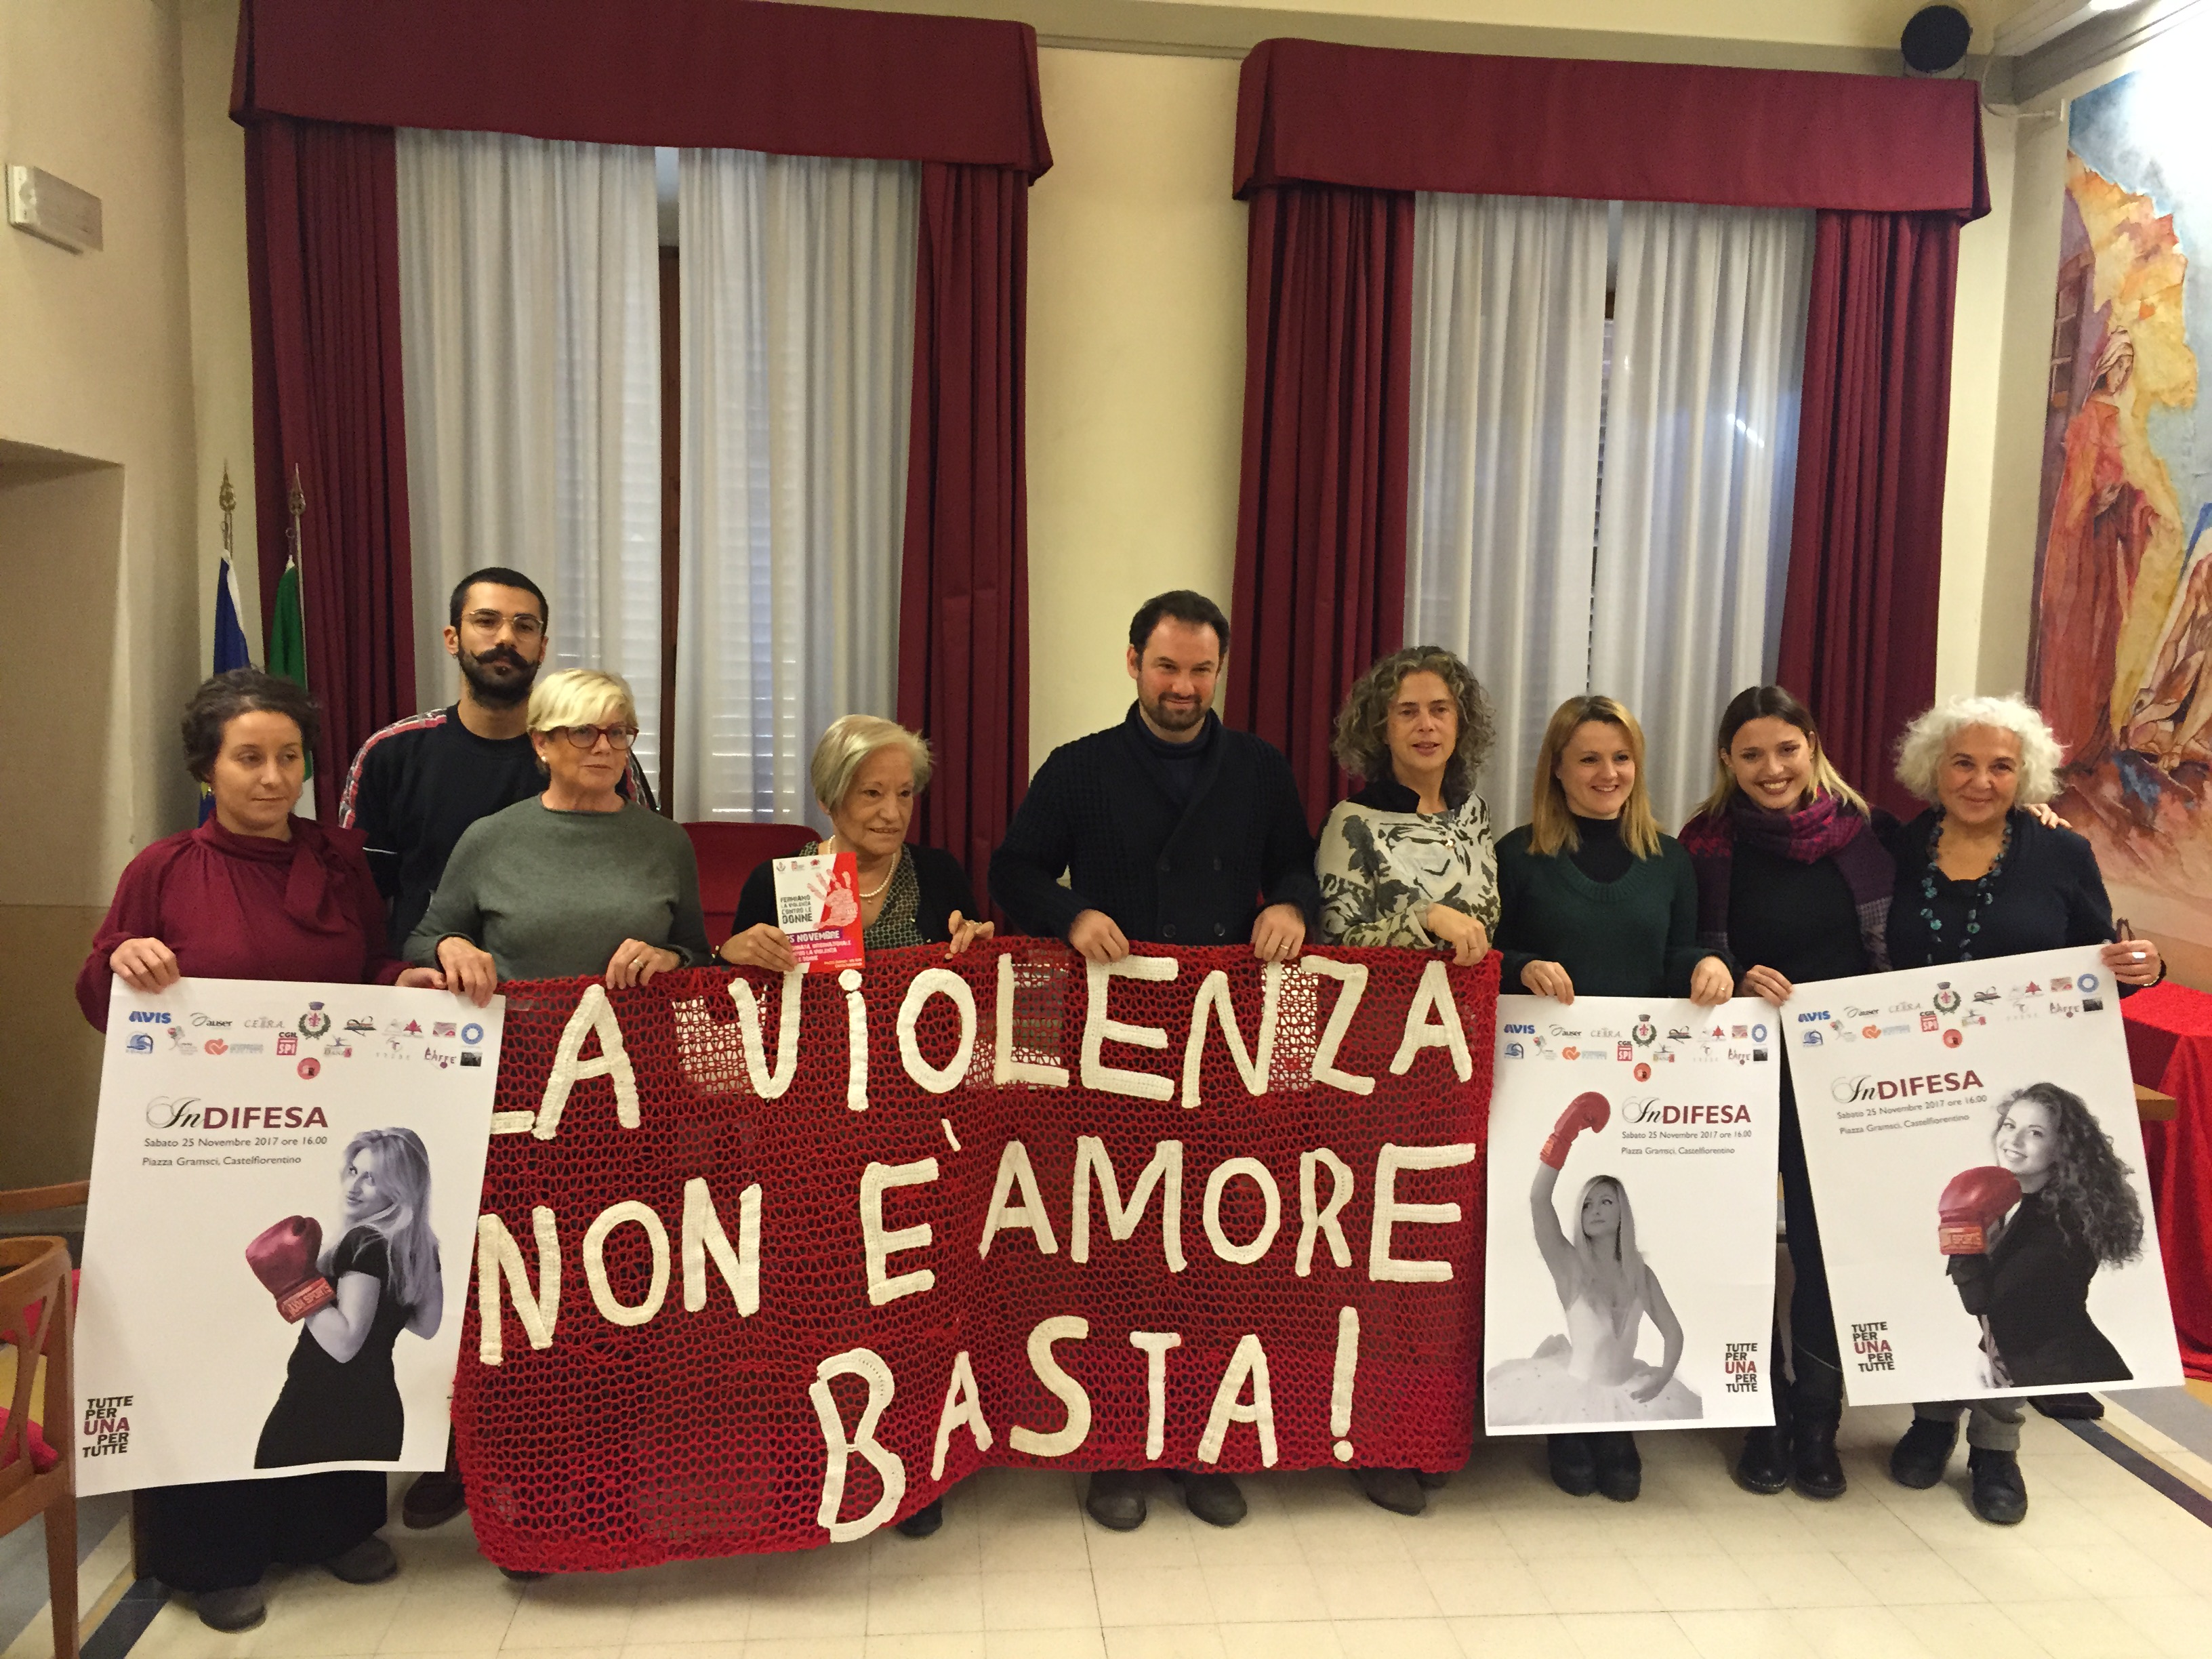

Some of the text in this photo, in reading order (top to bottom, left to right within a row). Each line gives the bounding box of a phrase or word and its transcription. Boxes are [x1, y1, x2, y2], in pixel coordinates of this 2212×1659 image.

[782, 913, 813, 924] DONNE
[796, 930, 840, 943] NOVEMBRE
[129, 1010, 171, 1024] AVIS
[1798, 1010, 1831, 1023] AVIS
[205, 1019, 233, 1027] auser
[1922, 1021, 1938, 1031] SPI
[1504, 1024, 1536, 1034] AVIS
[279, 1043, 296, 1054] SPI
[1618, 1050, 1633, 1061] SPI
[1837, 1111, 1864, 1120] Sabato
[1879, 1104, 1923, 1115] Novembre
[1925, 1100, 1944, 1109] 2017
[1904, 1114, 1970, 1128] Castelfiorentino
[1622, 1131, 1647, 1139] Sabato
[1700, 1130, 1718, 1139] 2017
[144, 1138, 179, 1147] Sabato
[182, 1138, 194, 1147] 25
[198, 1137, 251, 1147] Novembre
[254, 1137, 278, 1146] 2017
[302, 1136, 328, 1145] 16.00
[1621, 1147, 1643, 1155] Piazza
[1678, 1146, 1736, 1154] Castelfiorentino
[142, 1155, 302, 1166] Piazza Gramsci, Castelfiorentino
[478, 1177, 762, 1366] NON
[978, 1135, 1476, 1282] AMORE
[1851, 1322, 1888, 1333] TUTTE
[1852, 1331, 1878, 1342] PER
[1725, 1343, 1758, 1353] TUTTE
[1854, 1339, 1892, 1354] UNA
[1725, 1352, 1748, 1361] PER
[1868, 1352, 1893, 1362] PER
[1725, 1361, 1757, 1374] UNA
[1858, 1361, 1896, 1372] TUTTE
[1735, 1373, 1757, 1383] PER
[1725, 1382, 1758, 1393] TUTTE
[87, 1395, 134, 1410] TUTTE
[85, 1408, 117, 1420] PER
[83, 1416, 130, 1435] UNA
[97, 1432, 129, 1445] PER
[82, 1442, 128, 1458] TUTTE
